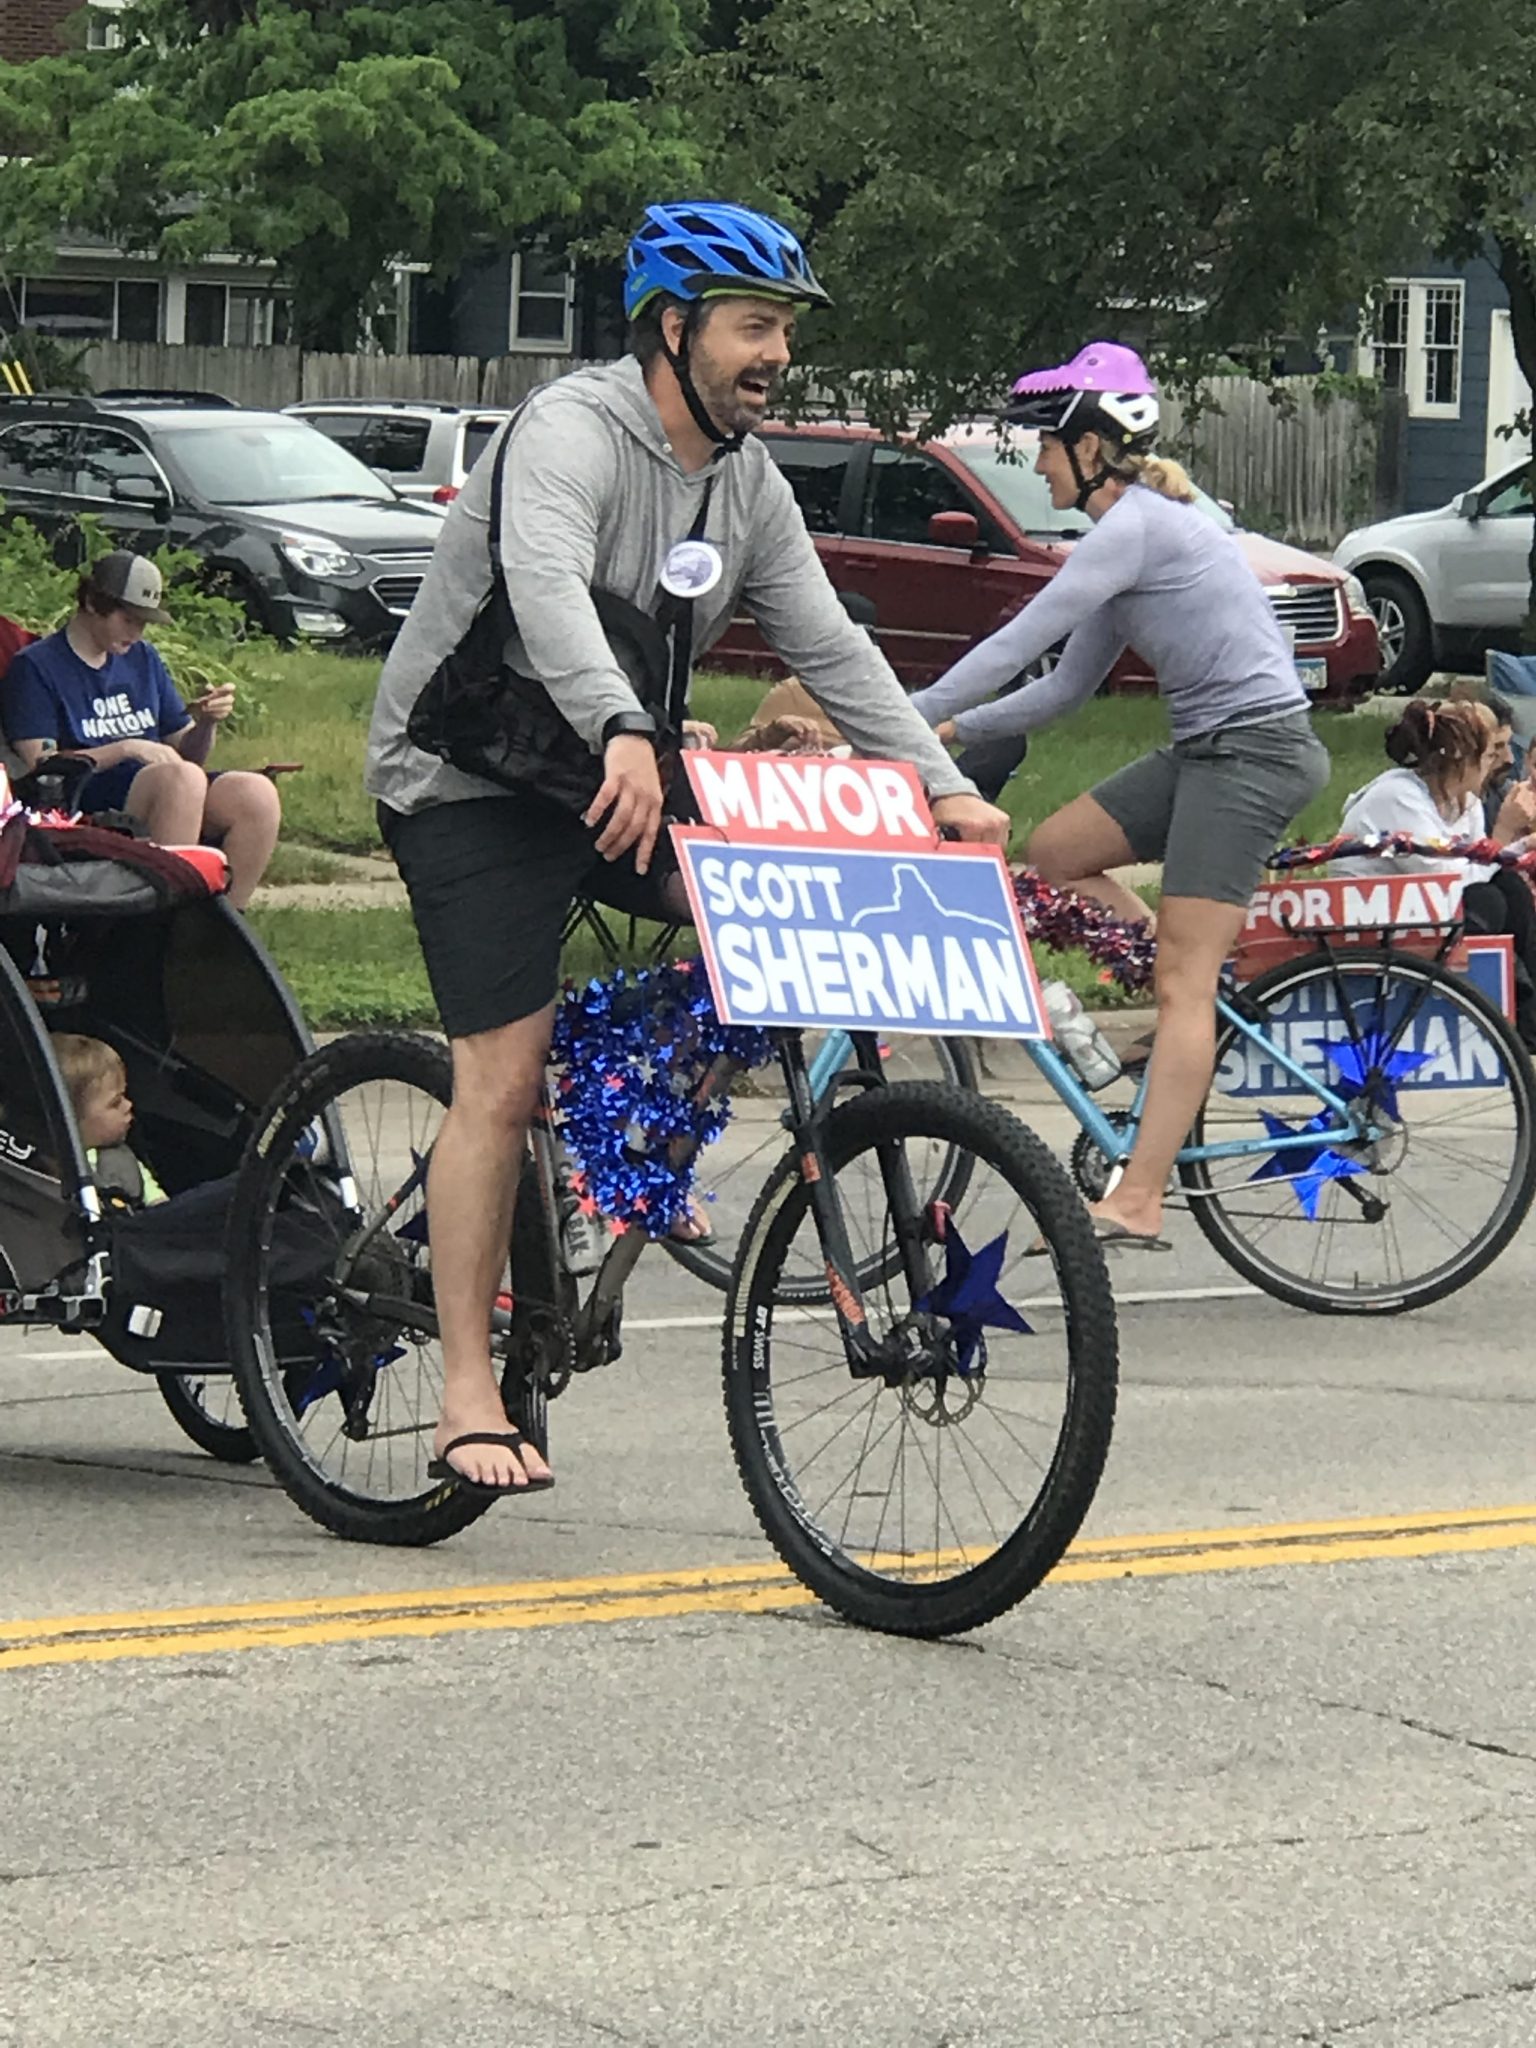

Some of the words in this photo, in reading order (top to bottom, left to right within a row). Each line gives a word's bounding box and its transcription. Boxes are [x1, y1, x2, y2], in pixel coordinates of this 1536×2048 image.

[81, 707, 156, 738] NATION
[93, 692, 131, 718] ONE
[692, 756, 932, 838] MAYOR
[699, 857, 845, 922] SCOTT
[1245, 887, 1335, 930] FOR
[716, 921, 1033, 1025] SHERMAN
[1213, 1015, 1500, 1092] SHEAN
